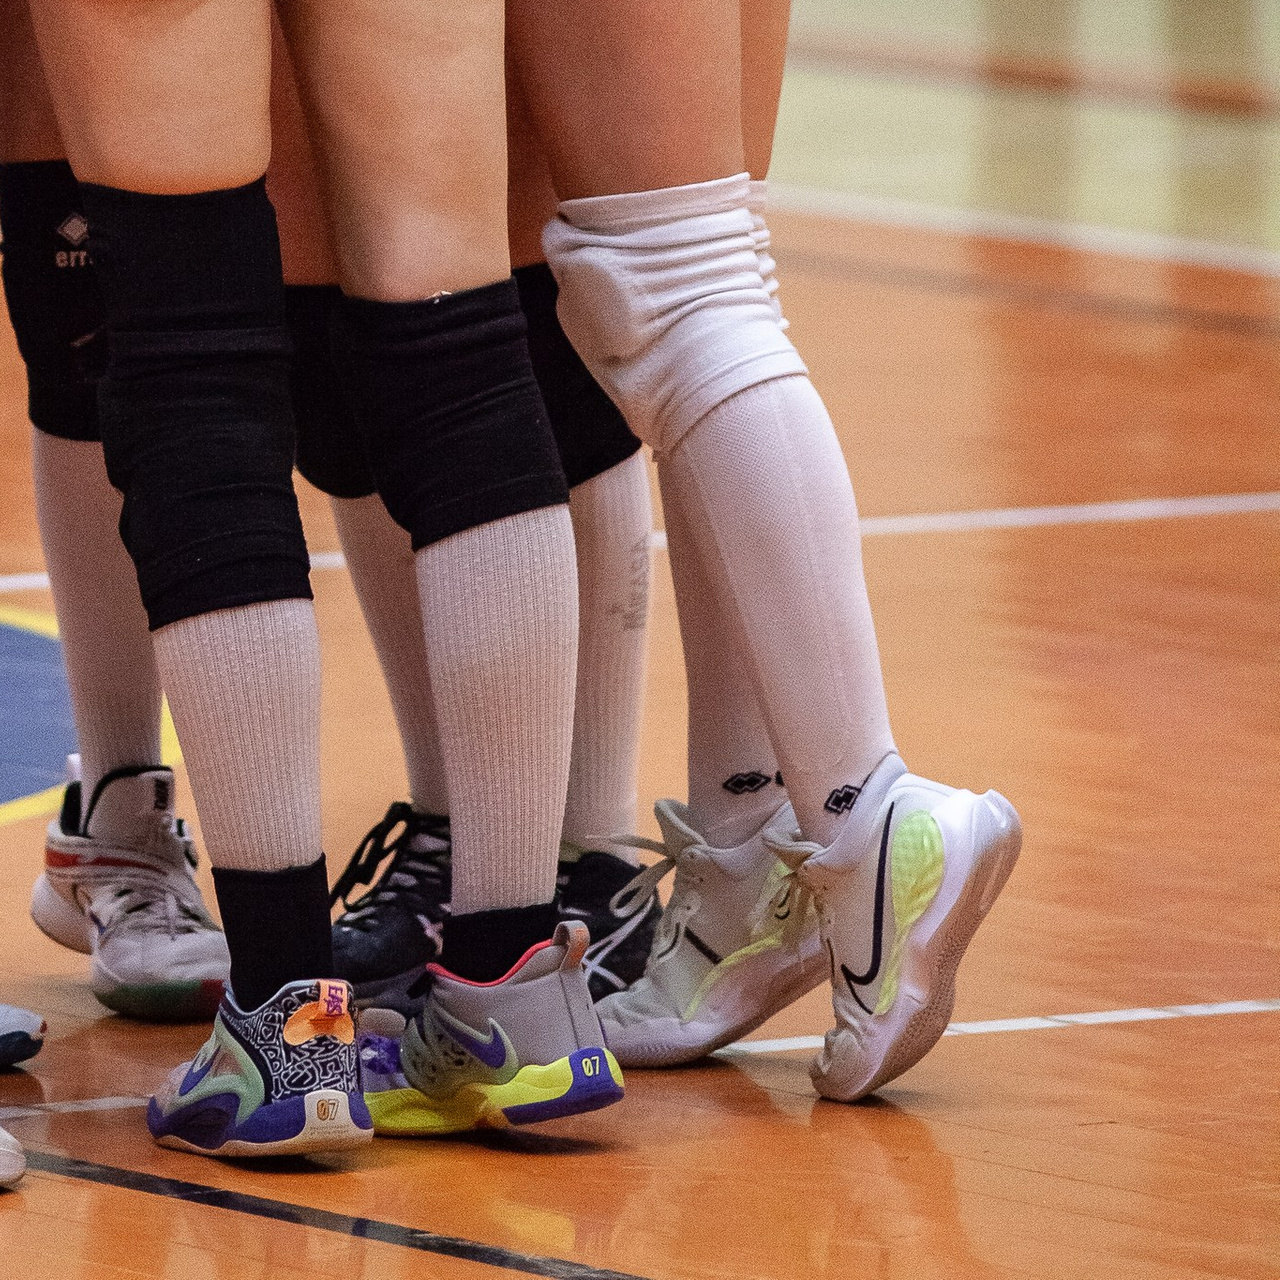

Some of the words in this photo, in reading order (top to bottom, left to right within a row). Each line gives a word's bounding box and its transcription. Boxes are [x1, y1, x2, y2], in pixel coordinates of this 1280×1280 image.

[55, 251, 94, 268] err
[581, 1056, 600, 1077] 07
[316, 1098, 340, 1121] 07
